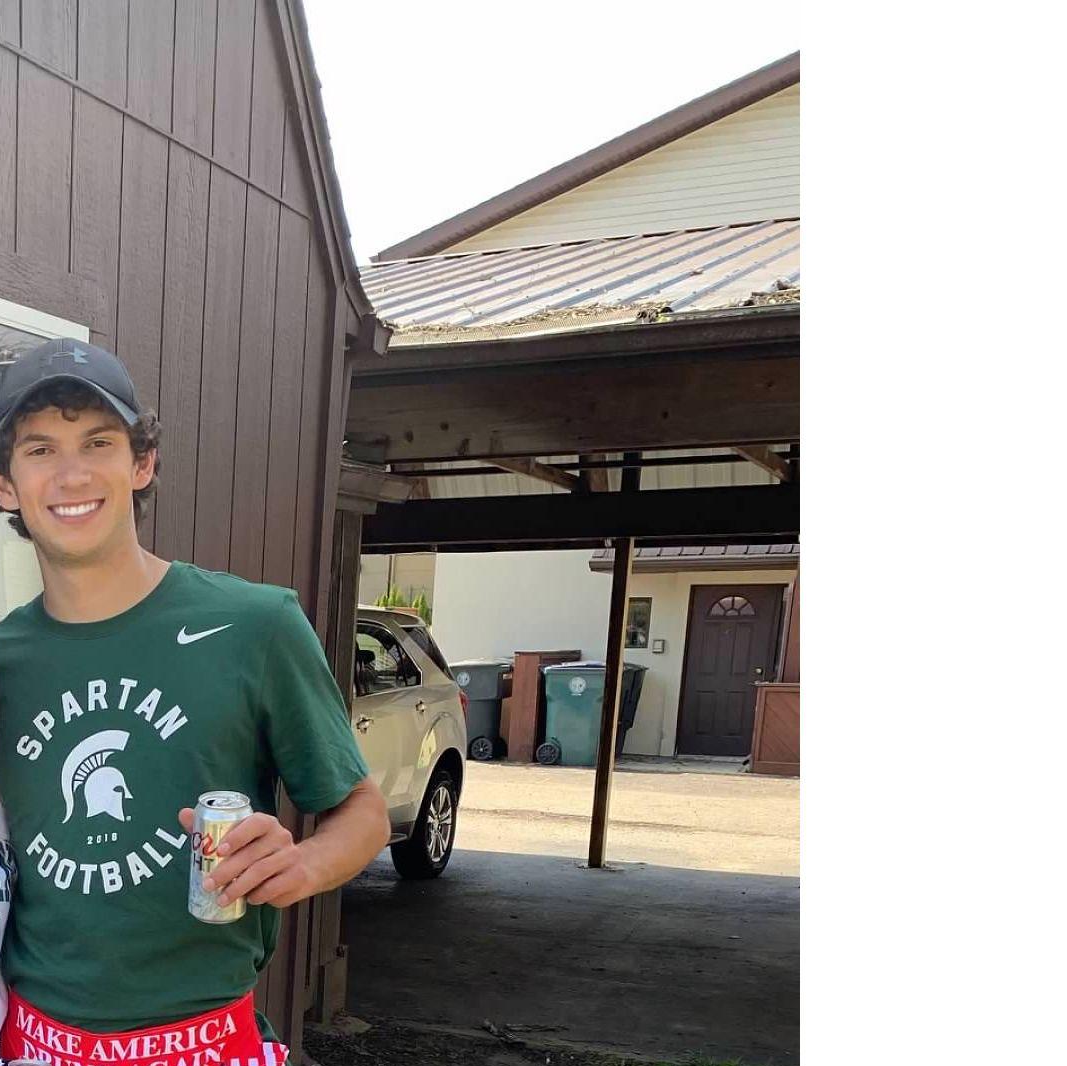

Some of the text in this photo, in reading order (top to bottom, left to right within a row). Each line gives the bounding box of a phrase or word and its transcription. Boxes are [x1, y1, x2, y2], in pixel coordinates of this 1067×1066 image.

[17, 678, 188, 760] SPARTAN
[26, 828, 188, 894] FOOTBALL
[87, 832, 118, 845] 2018
[16, 1005, 237, 1062] MAKE AMERICA
